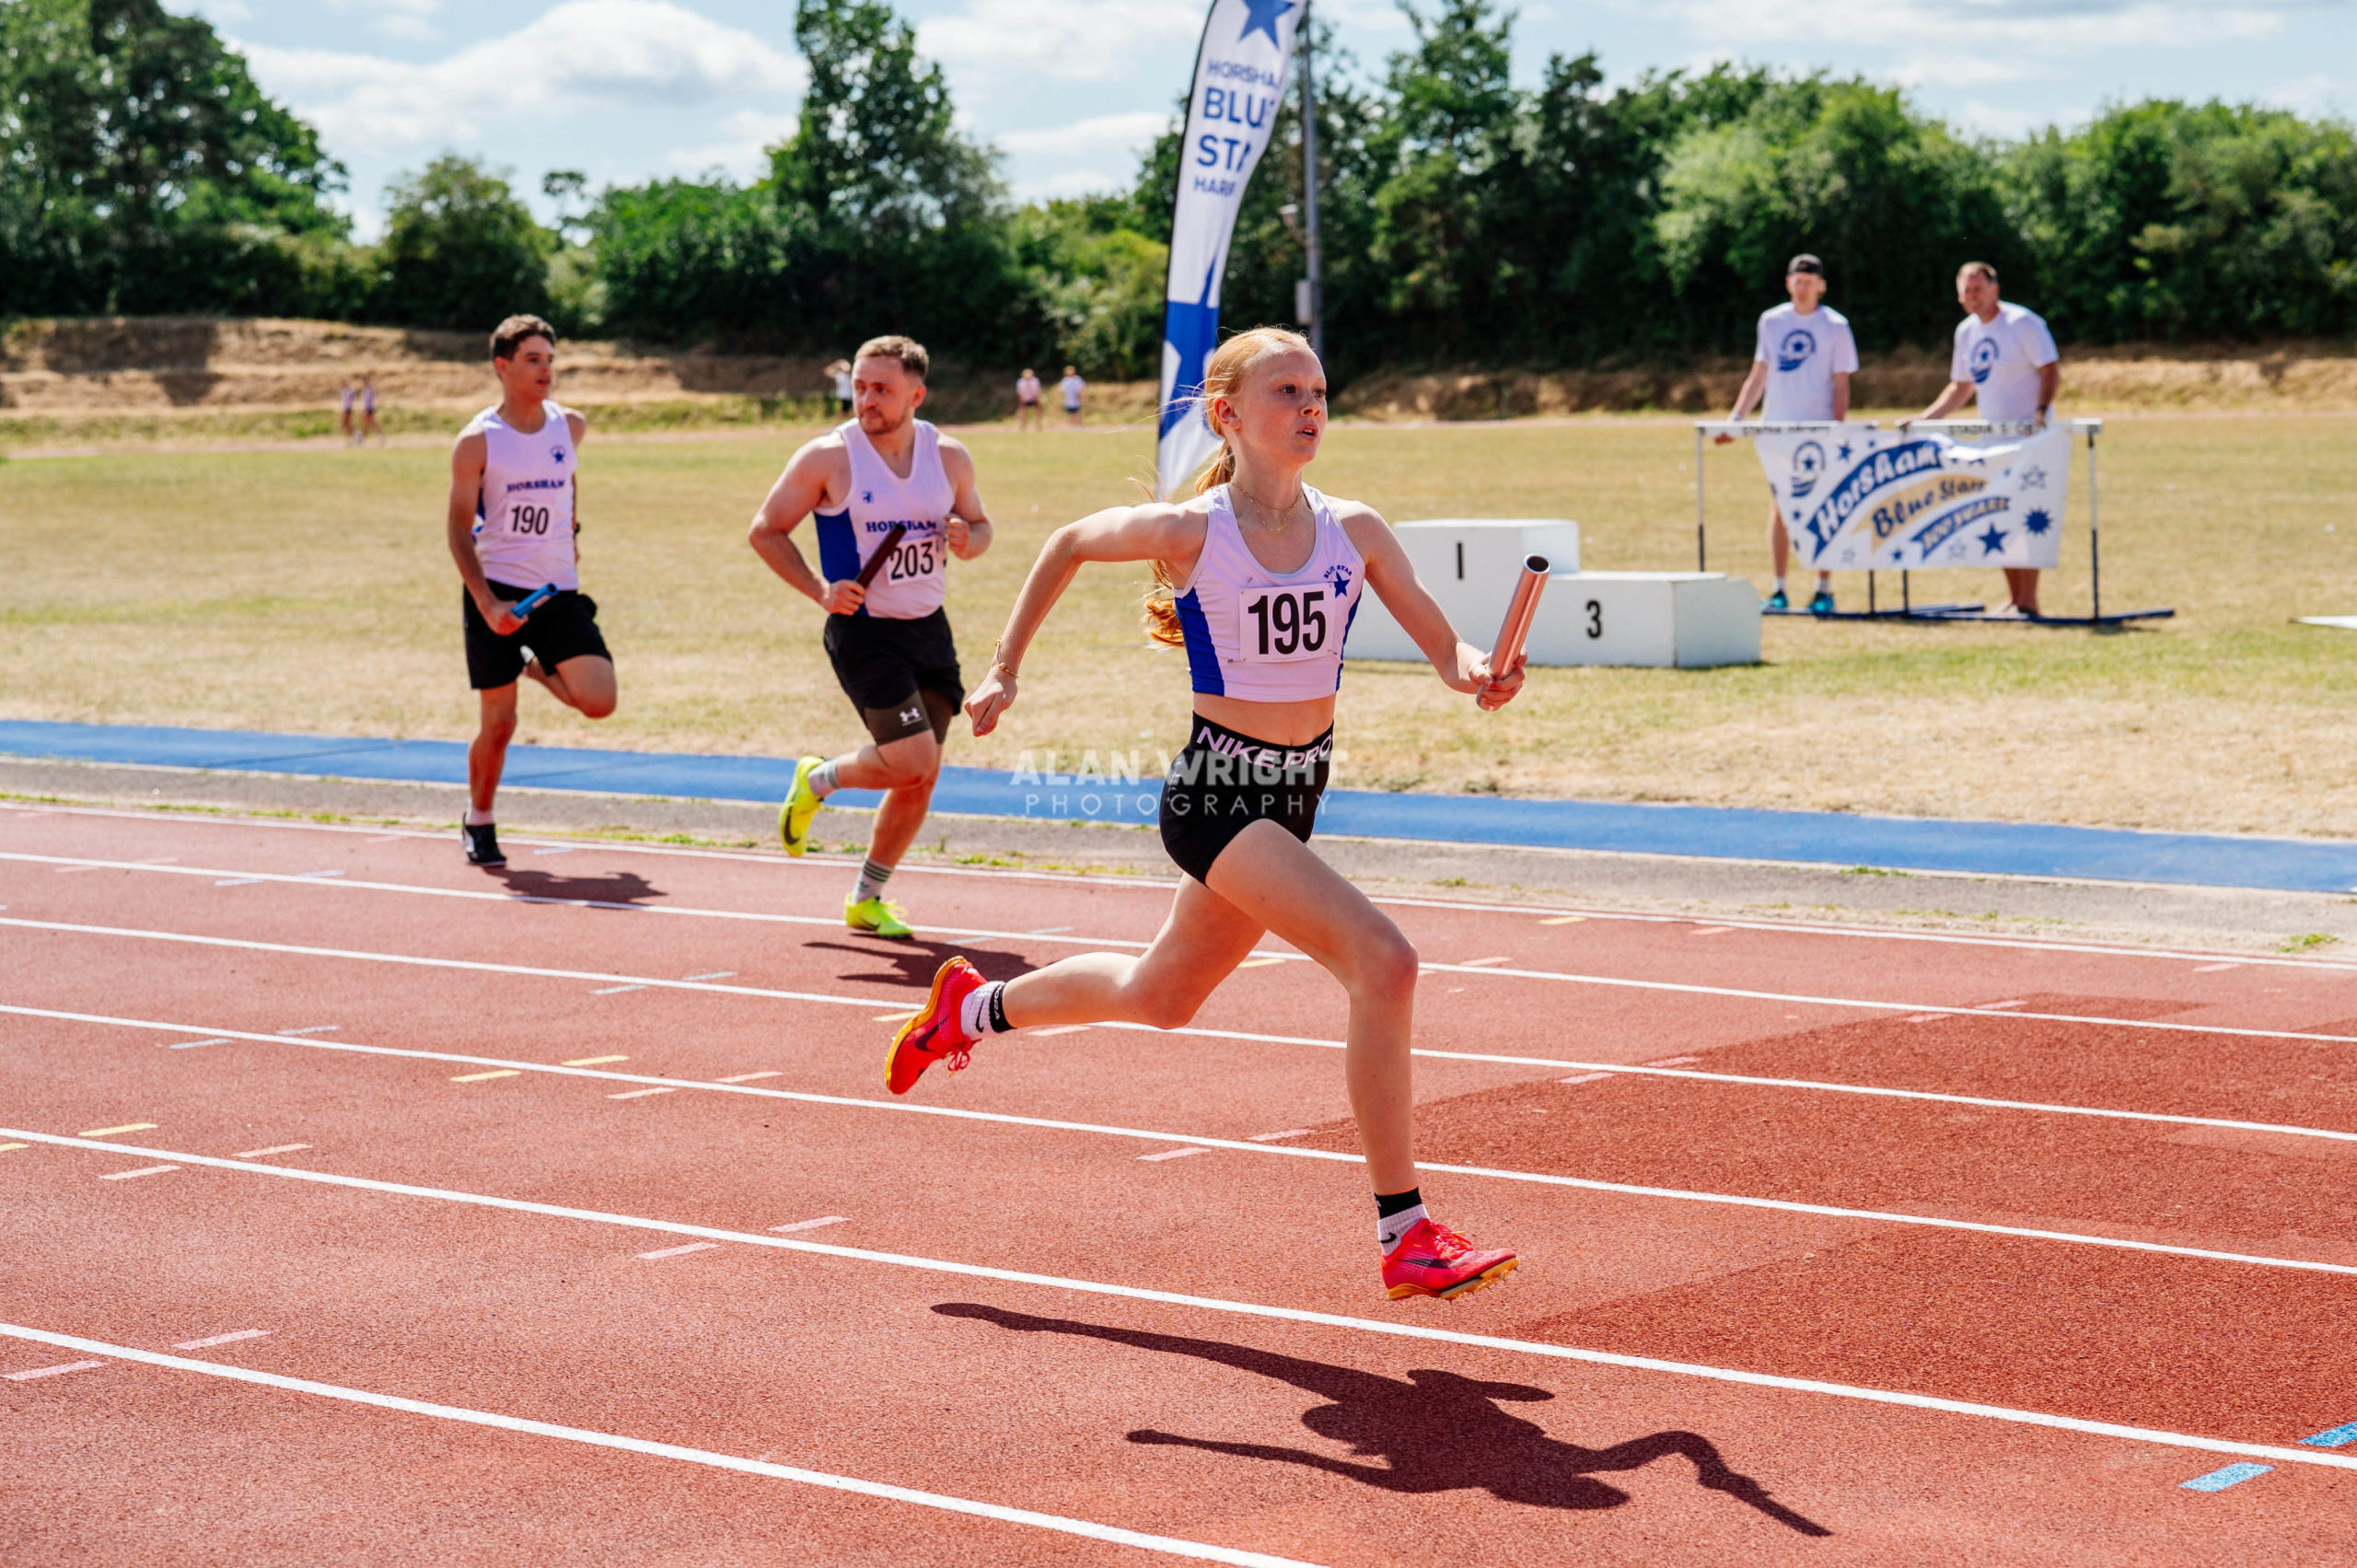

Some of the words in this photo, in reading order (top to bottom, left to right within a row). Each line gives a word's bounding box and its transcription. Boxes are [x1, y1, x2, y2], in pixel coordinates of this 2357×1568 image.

[1206, 60, 1281, 90] HORSHA
[1203, 87, 1275, 129] BLU
[511, 505, 549, 535] 190
[1872, 492, 1933, 539] Blue
[890, 541, 934, 580] 203
[1336, 564, 1353, 577] STAR
[1248, 590, 1326, 655] 195
[1586, 600, 1602, 639] 3
[1197, 726, 1283, 769] NIKE
[1282, 734, 1332, 771] PRO
